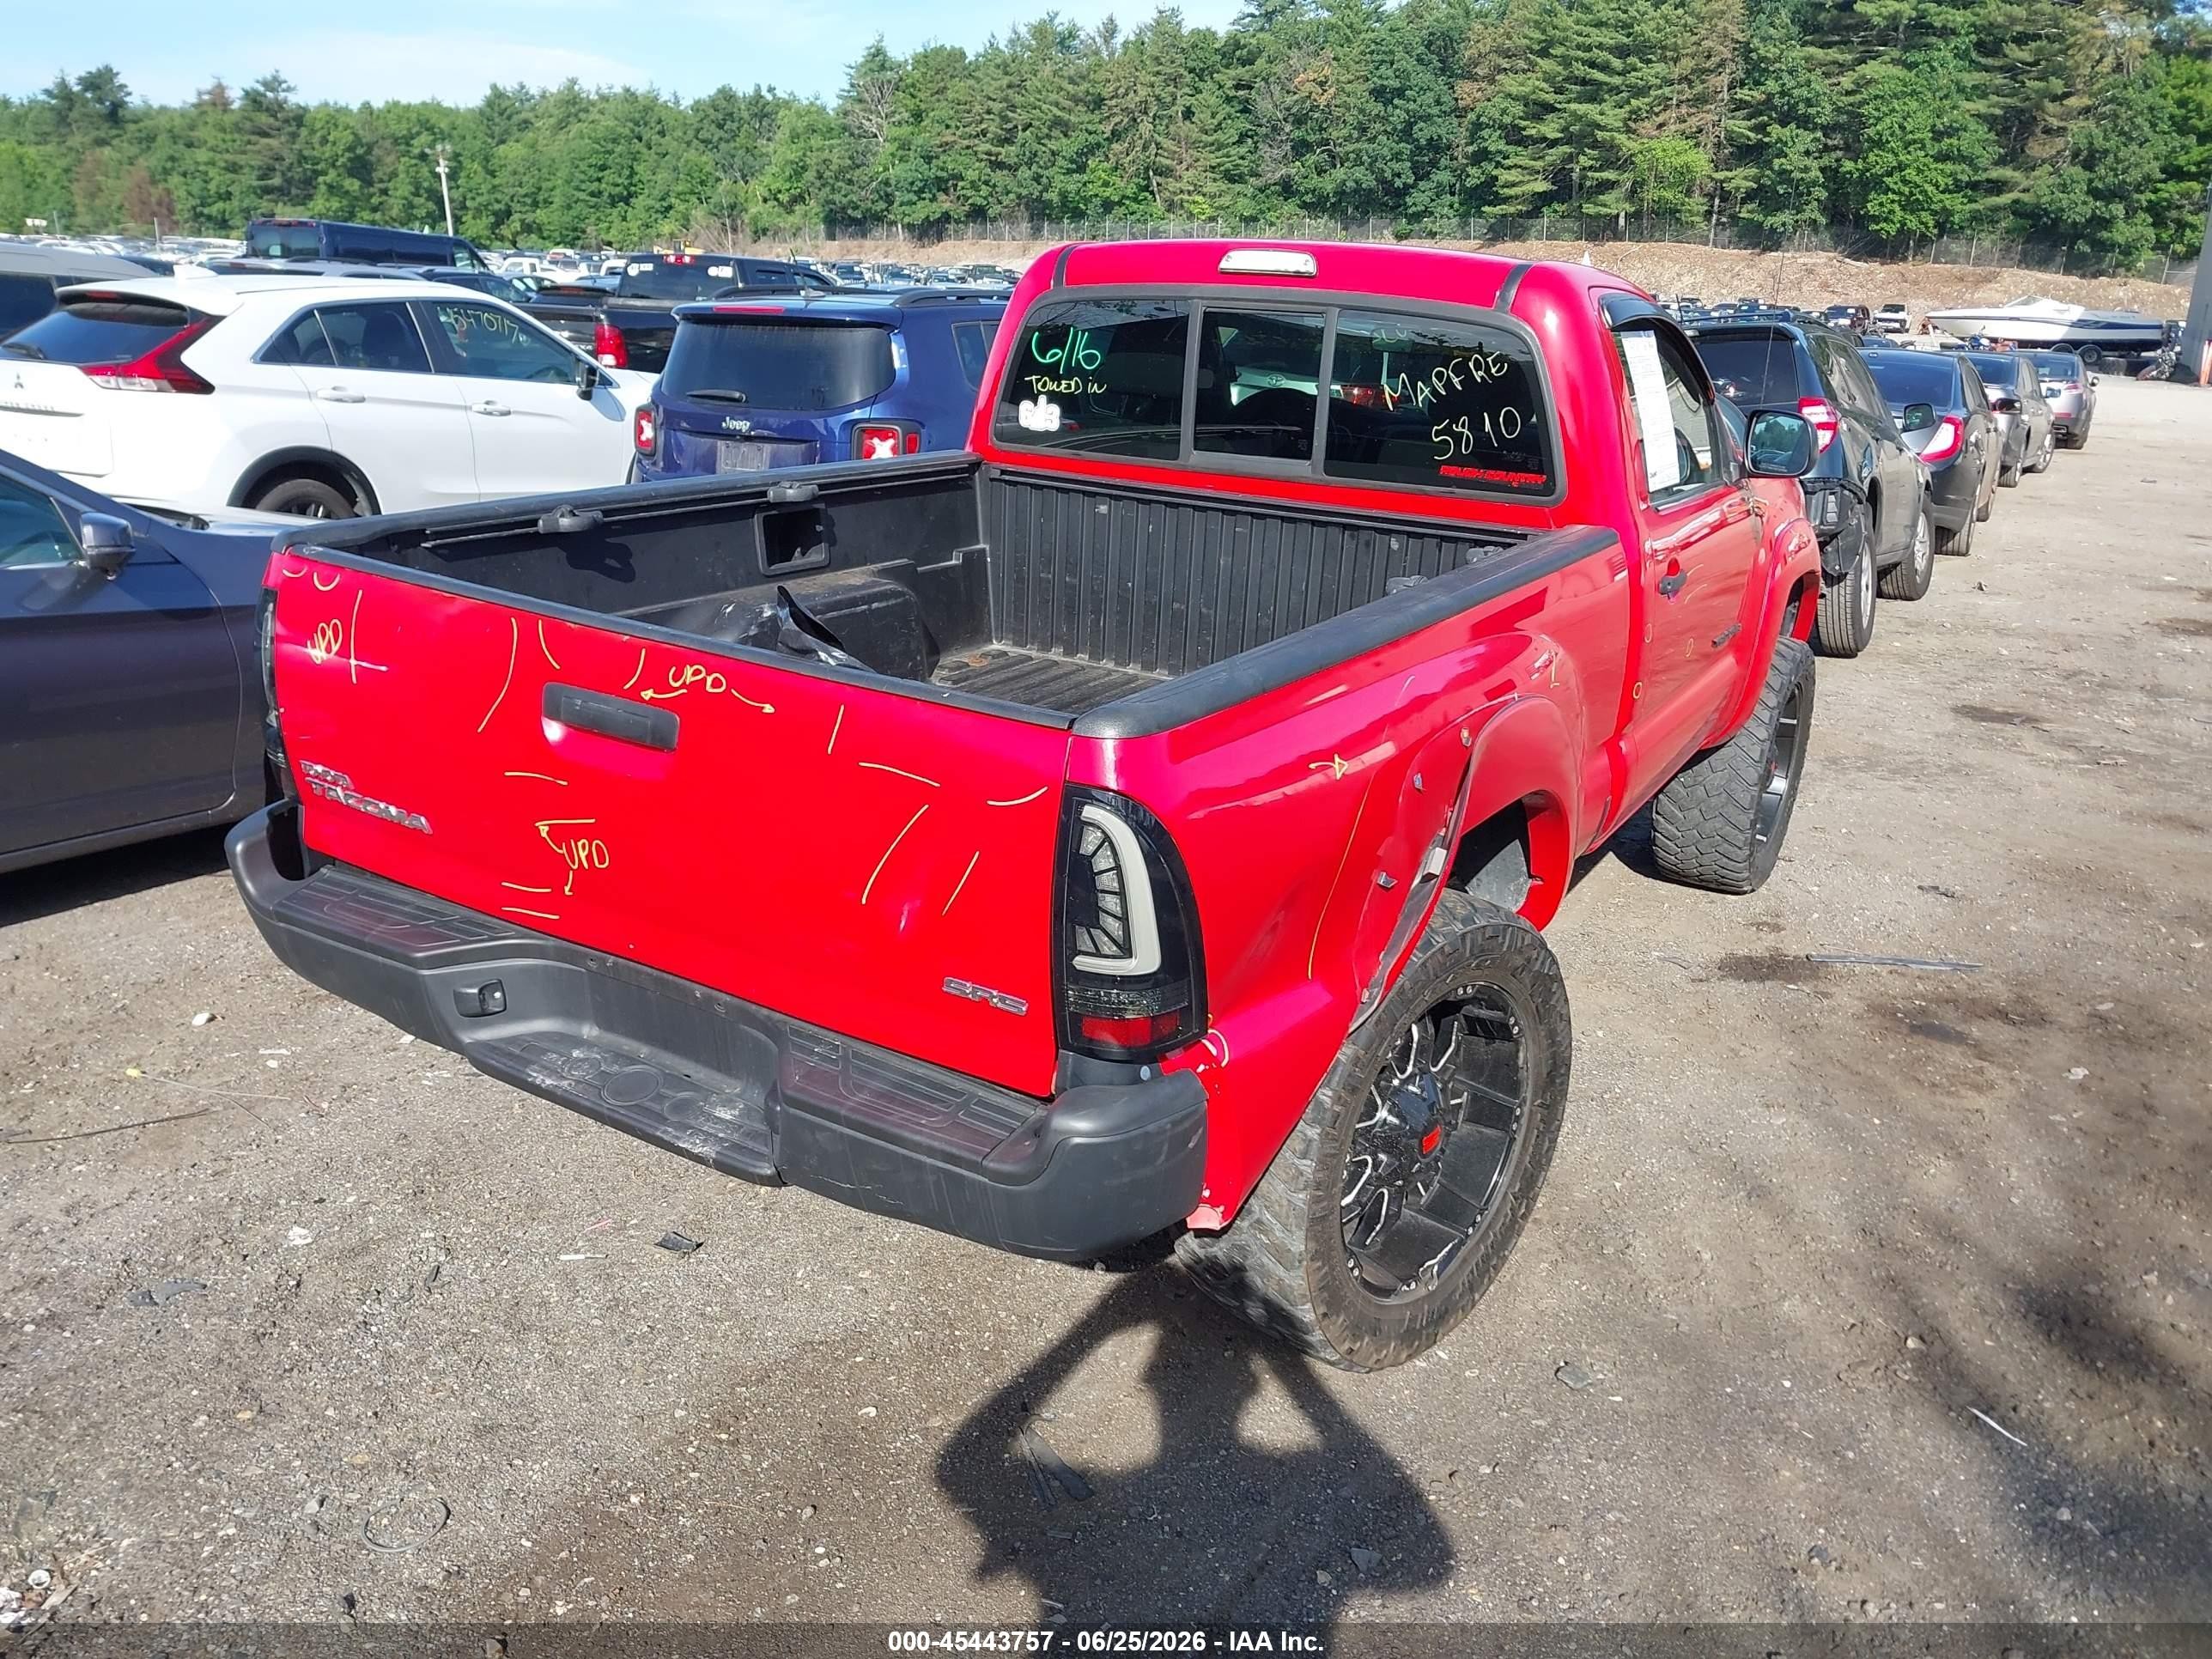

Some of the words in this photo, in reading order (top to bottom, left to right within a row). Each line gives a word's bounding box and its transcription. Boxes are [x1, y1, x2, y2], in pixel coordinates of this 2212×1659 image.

[1031, 326, 1102, 374] 6/16
[1383, 350, 1509, 411] MAPFRE
[721, 416, 751, 433] Jeep
[1431, 406, 1522, 460] 5810
[668, 664, 727, 693] UPD
[304, 776, 434, 835] TACOMA
[562, 838, 610, 870] UPD
